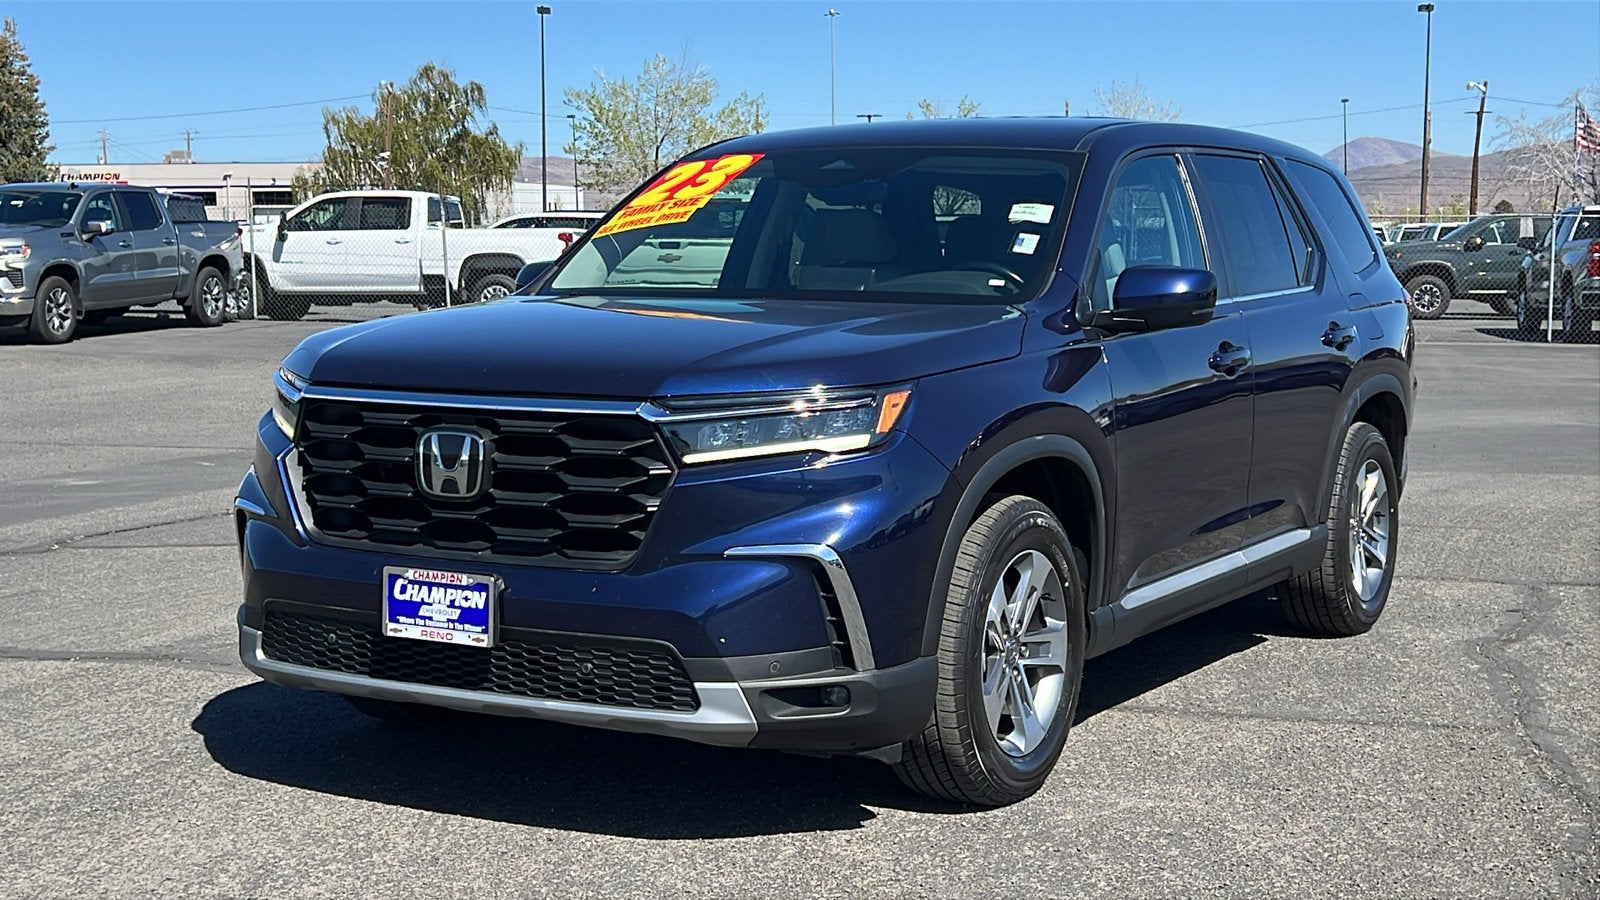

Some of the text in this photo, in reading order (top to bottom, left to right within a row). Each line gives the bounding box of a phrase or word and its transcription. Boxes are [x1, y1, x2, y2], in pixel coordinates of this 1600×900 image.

[61, 173, 120, 182] CHAMPION
[628, 154, 753, 208] 23
[618, 197, 704, 220] FAMILY SIZE
[617, 216, 654, 231] WHEEL
[655, 210, 692, 222] DRIVE
[412, 570, 464, 583] CHAMPION
[393, 578, 487, 610] CHAMPION
[422, 606, 458, 617] CHEVROLET
[420, 629, 453, 641] RENO
